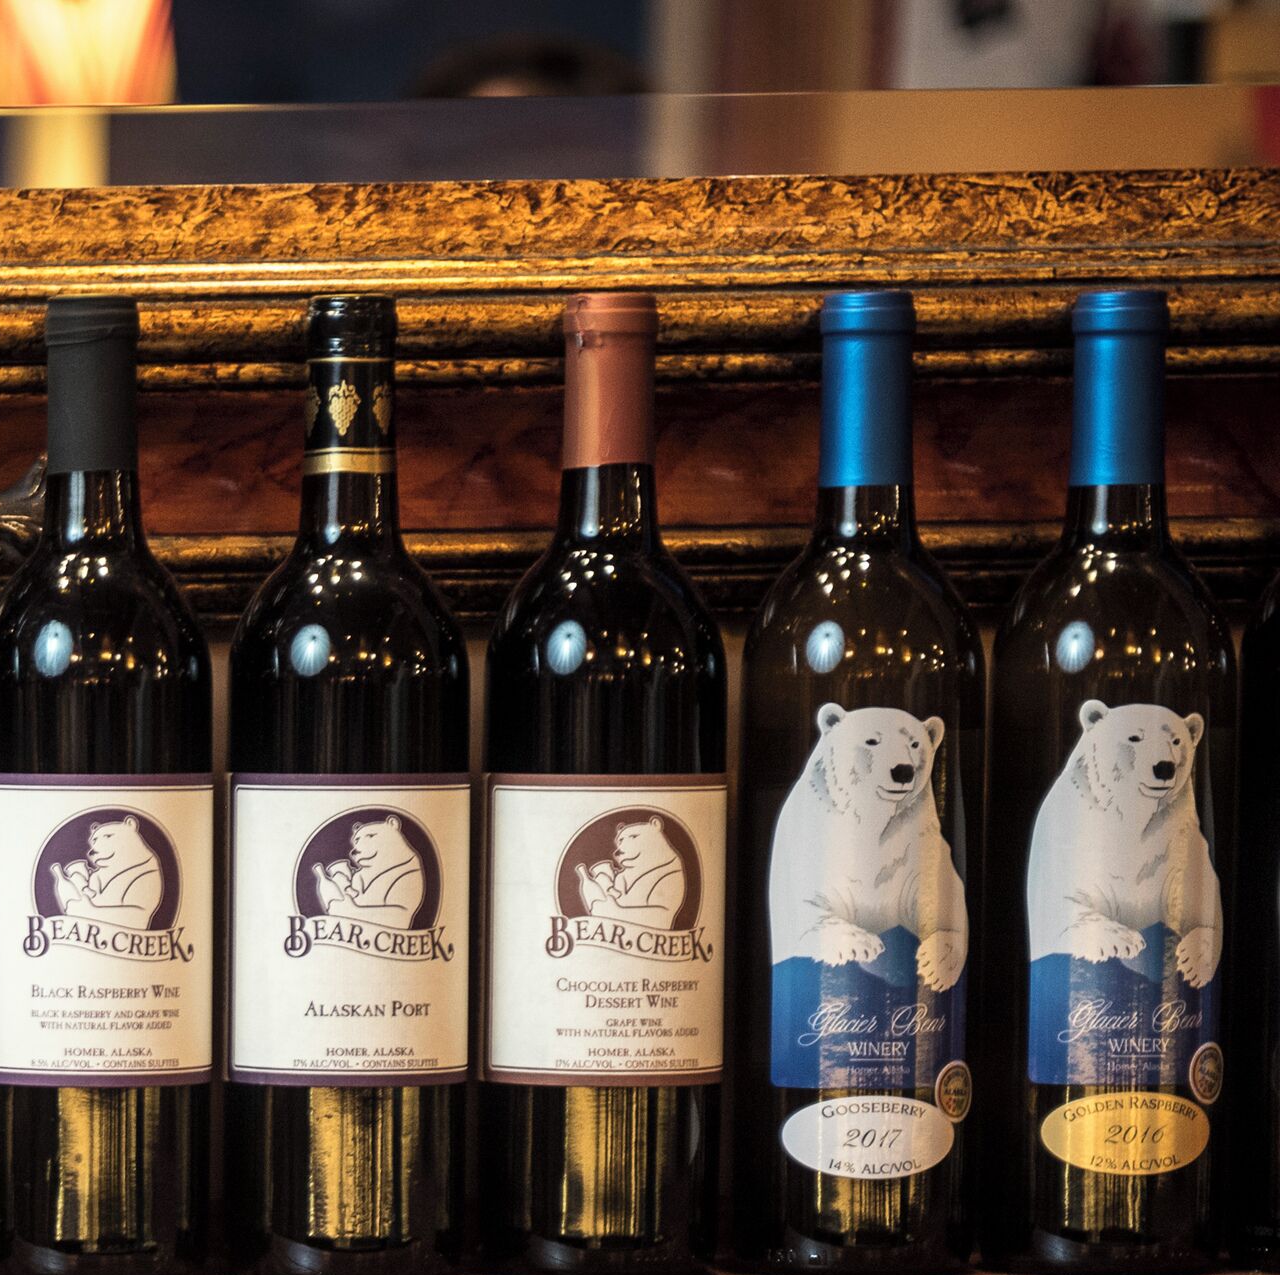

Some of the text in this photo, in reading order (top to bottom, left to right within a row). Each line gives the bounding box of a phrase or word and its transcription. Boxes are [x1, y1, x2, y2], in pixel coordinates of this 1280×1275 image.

[23, 914, 194, 962] BEAR CREEK
[283, 914, 454, 962] BEAR CREEK
[545, 916, 713, 963] BEAR CREEK
[31, 984, 181, 999] BLACK RASPBERRY WINE
[556, 977, 700, 993] CHOCOLATE RASPBERRY
[304, 1000, 431, 1017] ALASKAN PORT
[585, 994, 679, 1009] DESSERT WINE
[797, 1002, 946, 1047] Glacier Bear
[1057, 999, 1203, 1043] Glacier Bear
[110, 1048, 153, 1057] ALASKA
[373, 1047, 415, 1056] ALASKA
[635, 1048, 676, 1057] ALASKA
[846, 1041, 910, 1057] WINERY
[1108, 1038, 1170, 1053] WINERY
[821, 1102, 927, 1119] GOOSEBERRY
[1063, 1096, 1198, 1123] GOLDEN RASPBERRY
[842, 1128, 903, 1149] 2017
[1104, 1124, 1168, 1144] 2016
[828, 1159, 856, 1173] 14%
[1090, 1155, 1117, 1170] 12%
